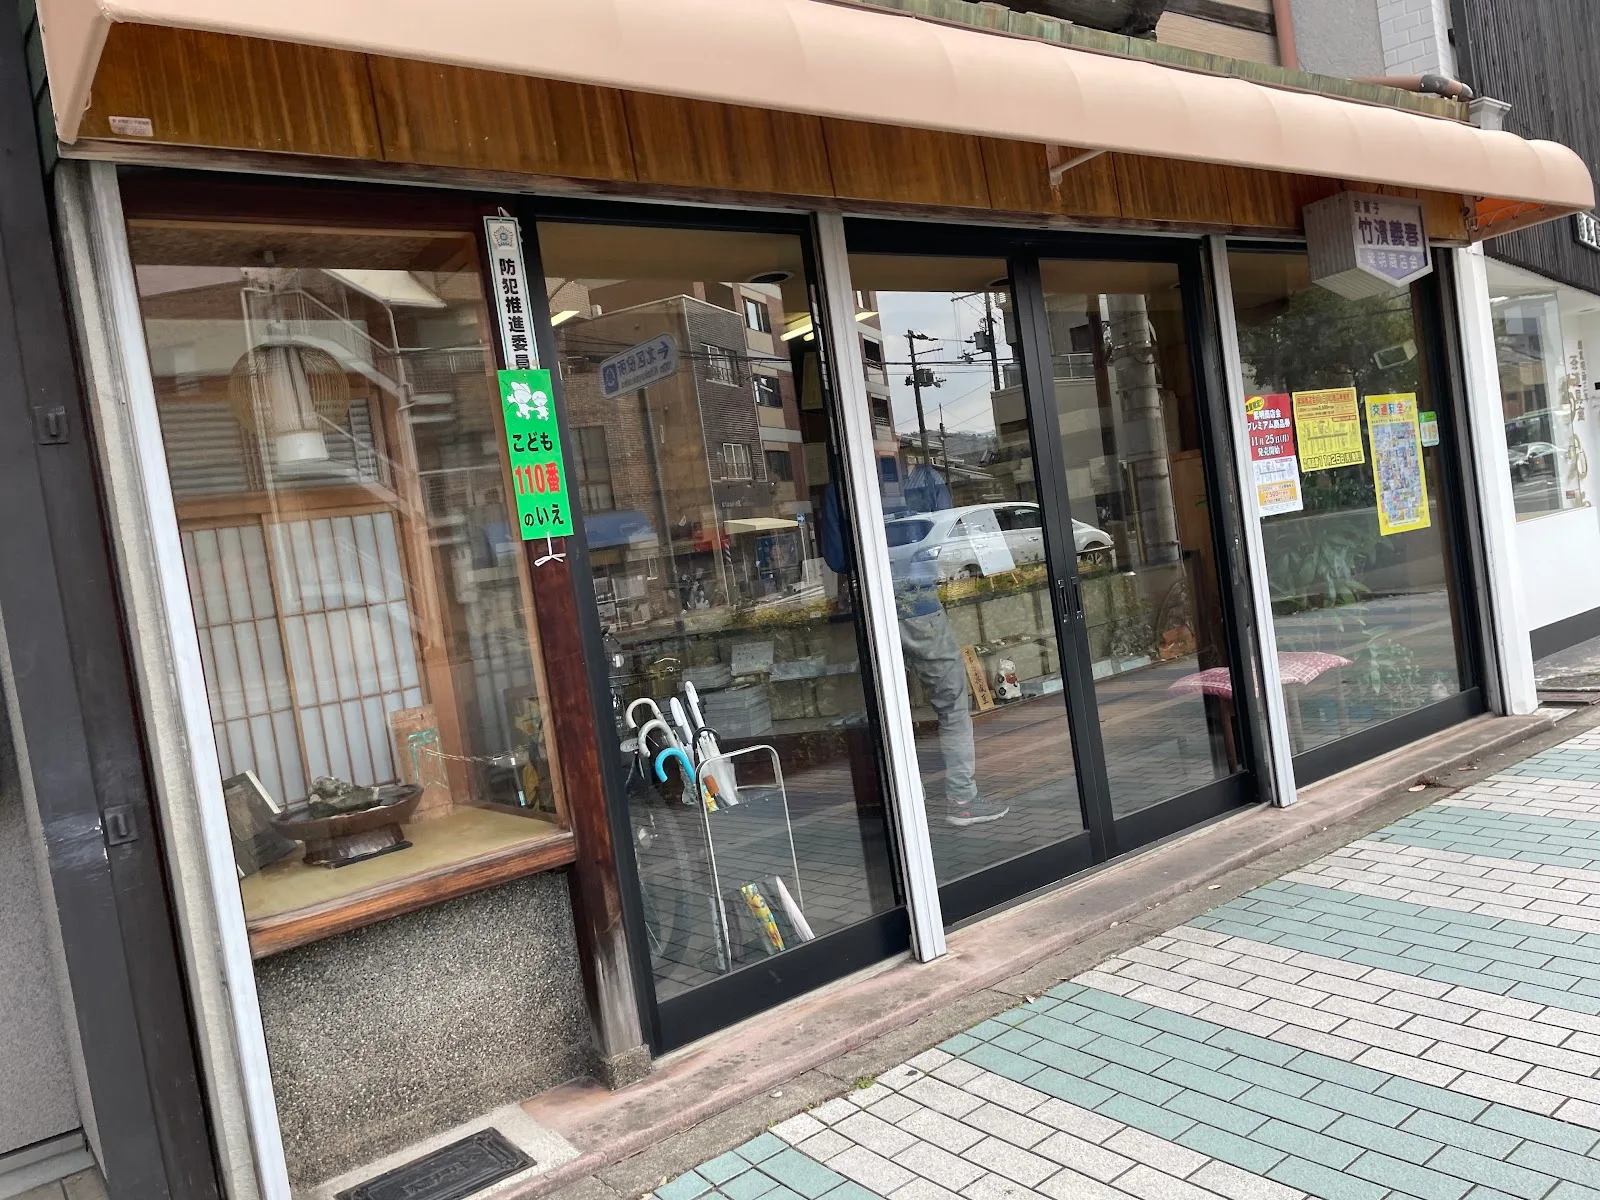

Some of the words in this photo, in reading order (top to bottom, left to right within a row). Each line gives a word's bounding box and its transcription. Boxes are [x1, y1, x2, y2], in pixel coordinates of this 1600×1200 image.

[498, 258, 531, 370] 防犯推進委員
[512, 432, 553, 452] こども
[514, 462, 560, 495] 110番
[524, 504, 565, 527] のいえ
